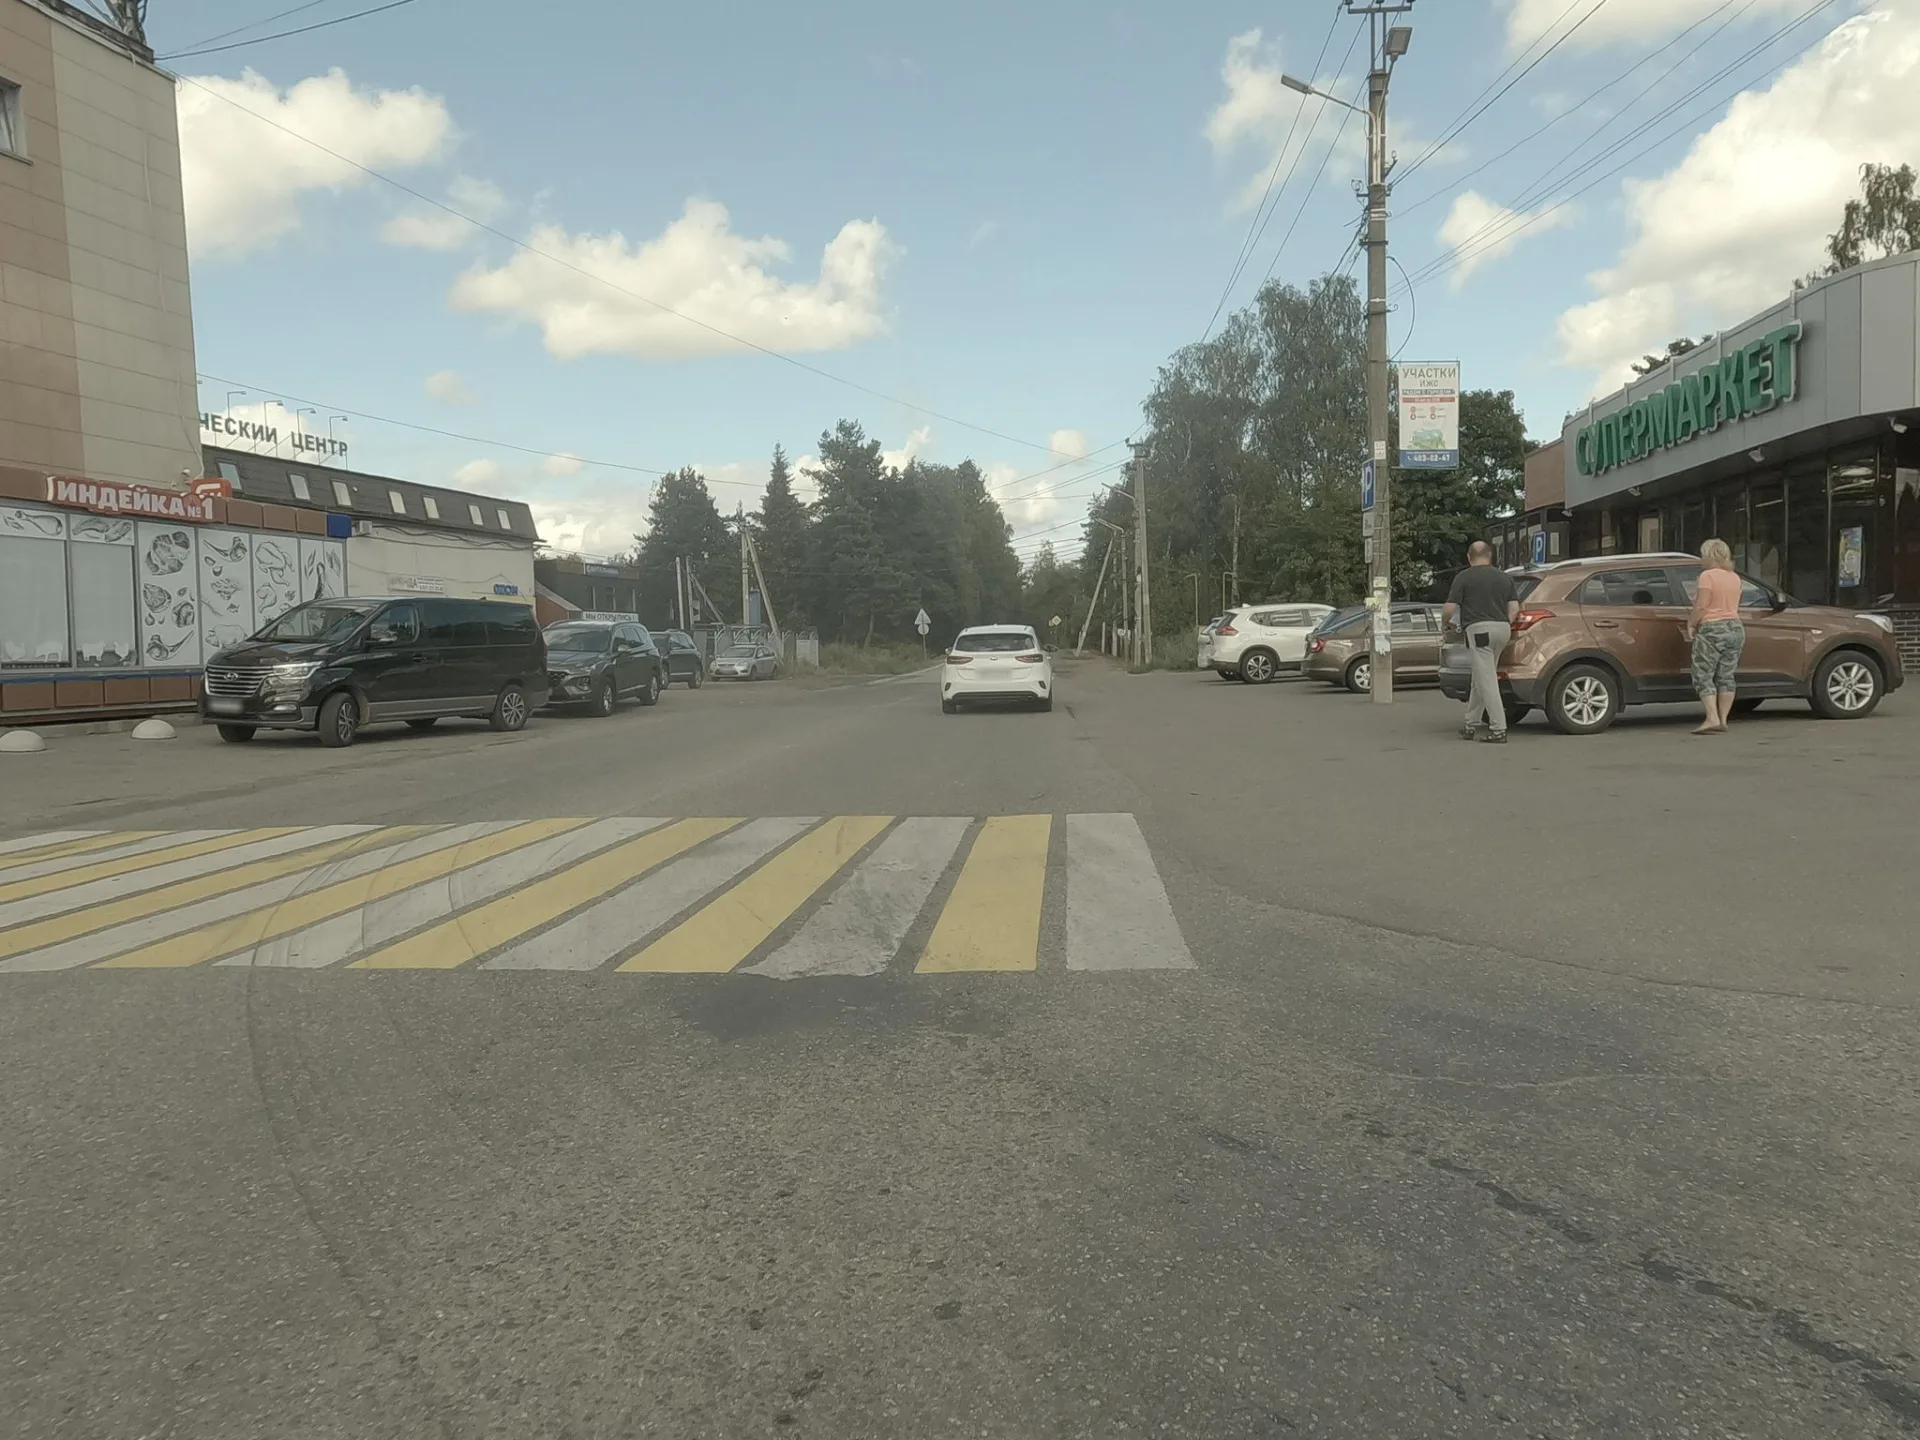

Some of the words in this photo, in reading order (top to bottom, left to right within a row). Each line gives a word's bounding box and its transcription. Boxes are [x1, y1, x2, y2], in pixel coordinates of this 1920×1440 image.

[1402, 367, 1456, 379] УЧАСТКИ
[1575, 320, 1802, 476] СУПЕРМАРКЕТ
[291, 431, 348, 456] ЦЕНТР
[57, 480, 186, 516] ИНДЕЙКА
